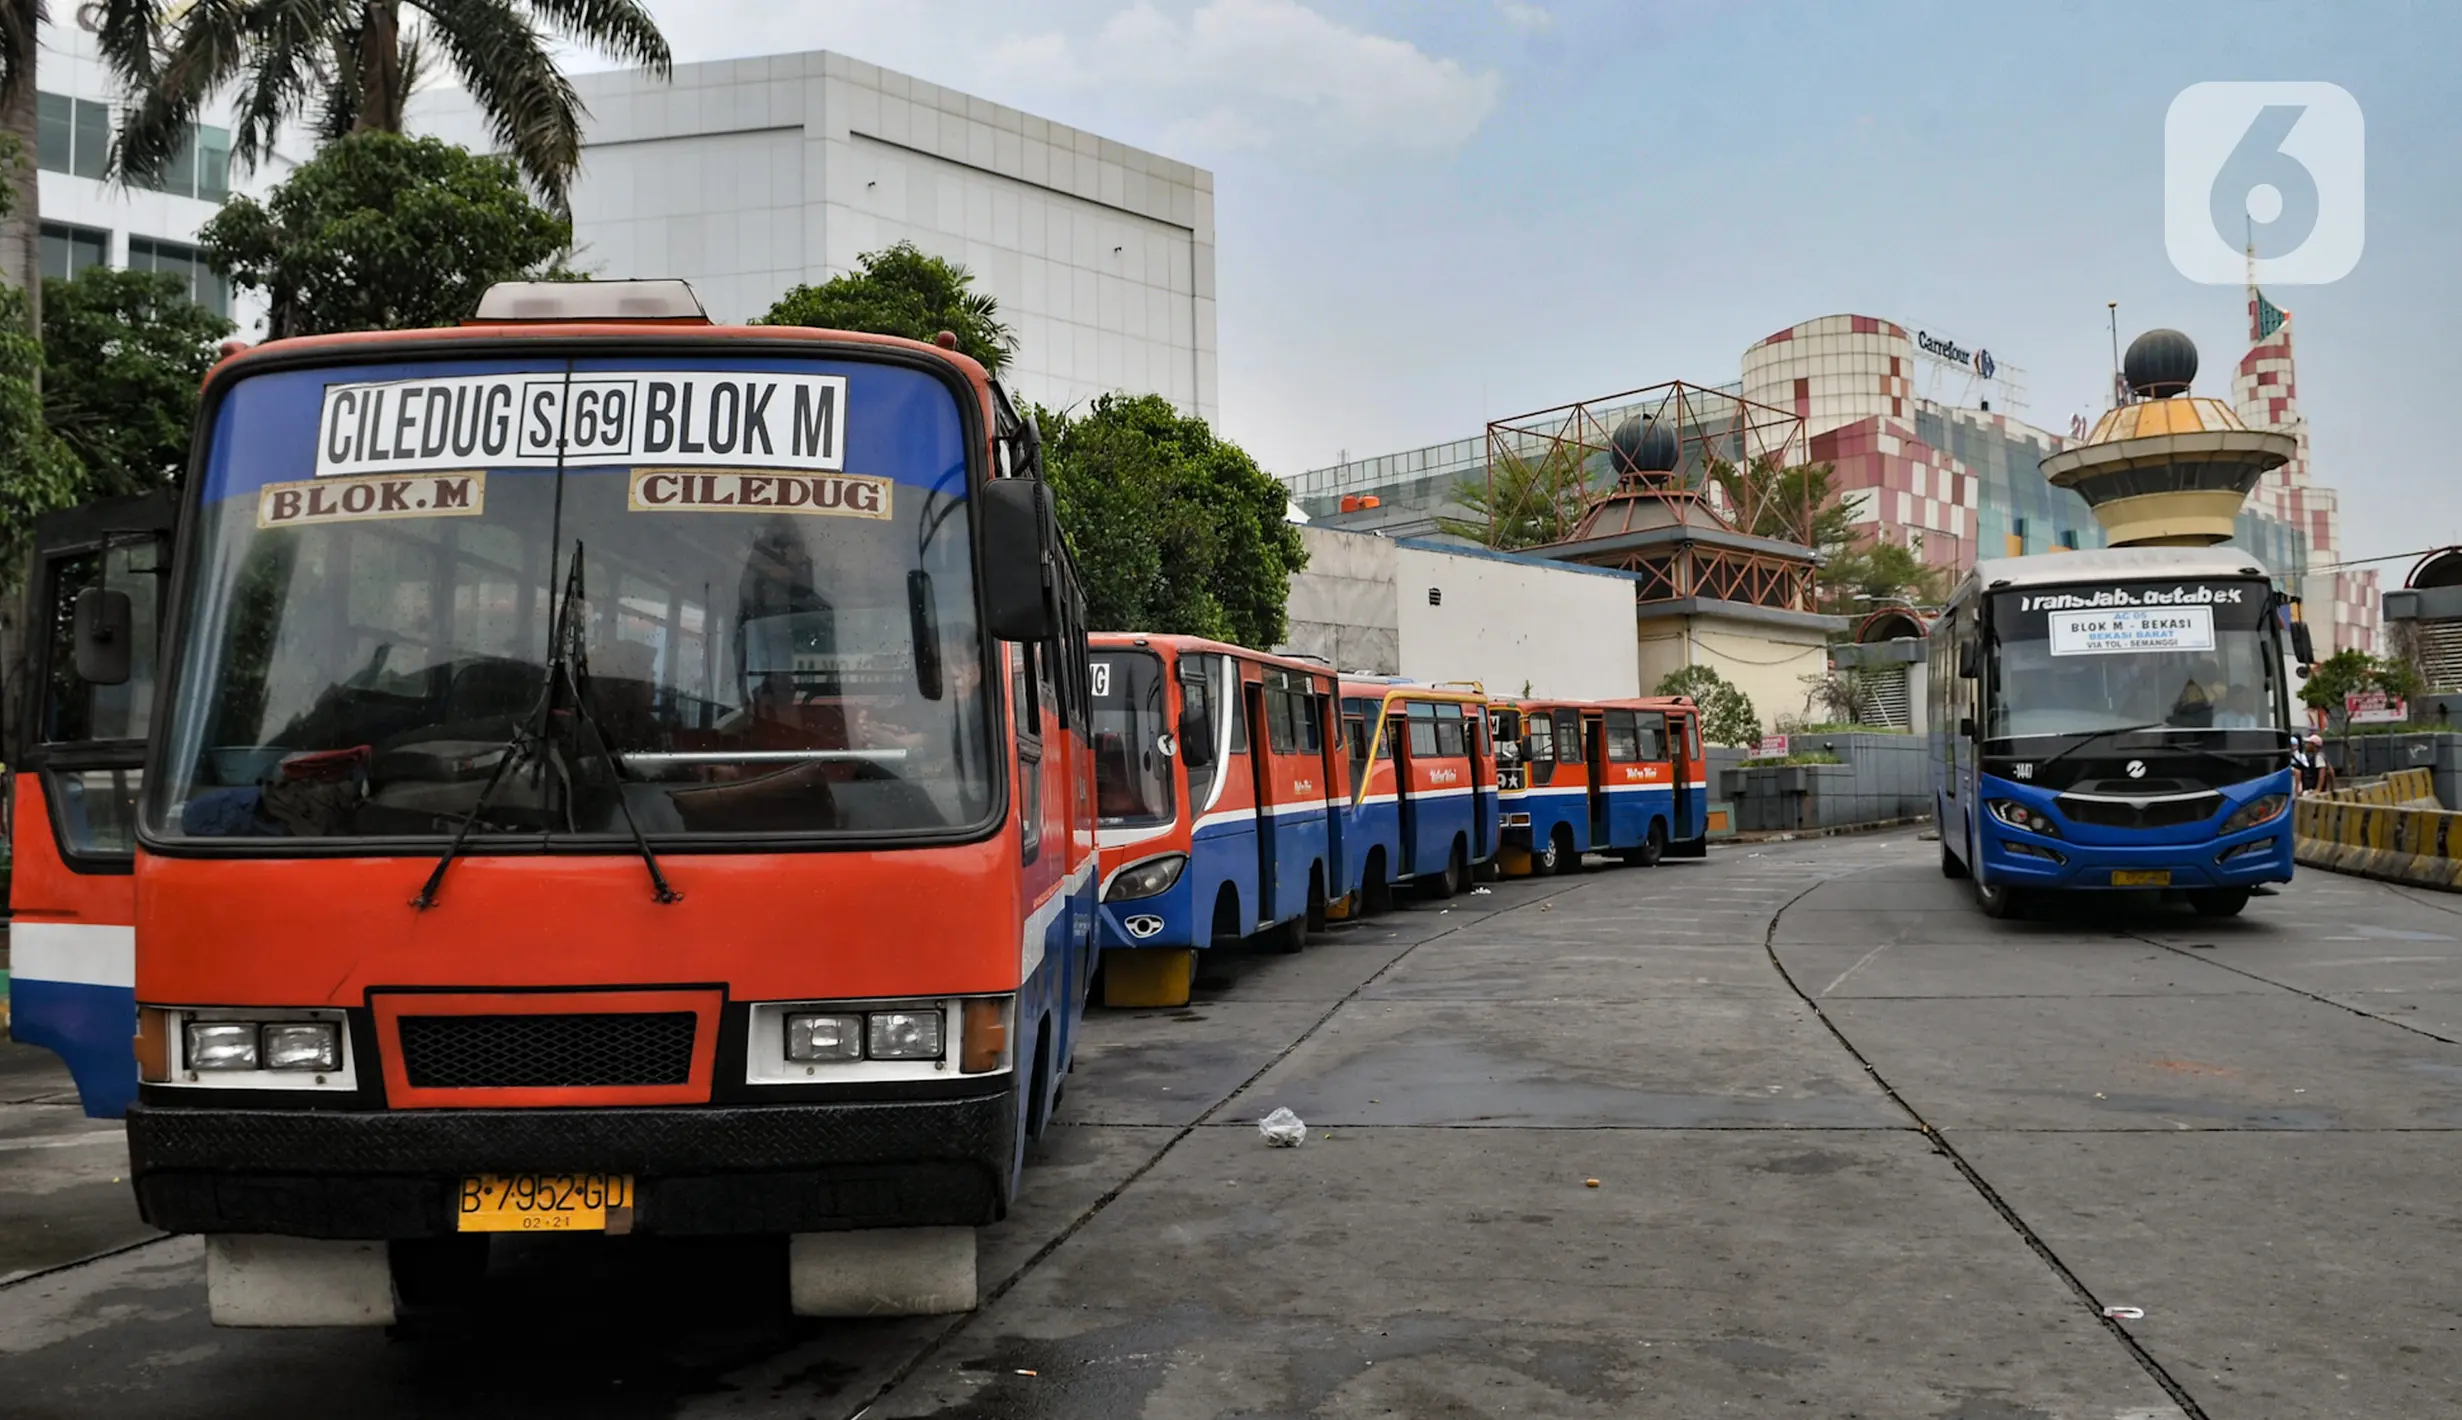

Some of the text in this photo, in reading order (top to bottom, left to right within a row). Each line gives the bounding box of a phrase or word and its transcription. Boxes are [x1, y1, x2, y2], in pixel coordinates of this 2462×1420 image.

[1918, 330, 1969, 365] Carrefour
[328, 383, 512, 464] CILEDUG
[643, 381, 835, 459] BLOK M
[271, 478, 470, 521] BLOK.M
[643, 474, 880, 513] CILEDUG
[2071, 621, 2107, 633] BLOK
[2113, 621, 2123, 631] M
[2142, 618, 2192, 630] BEKASI
[2087, 641, 2102, 649] VIA
